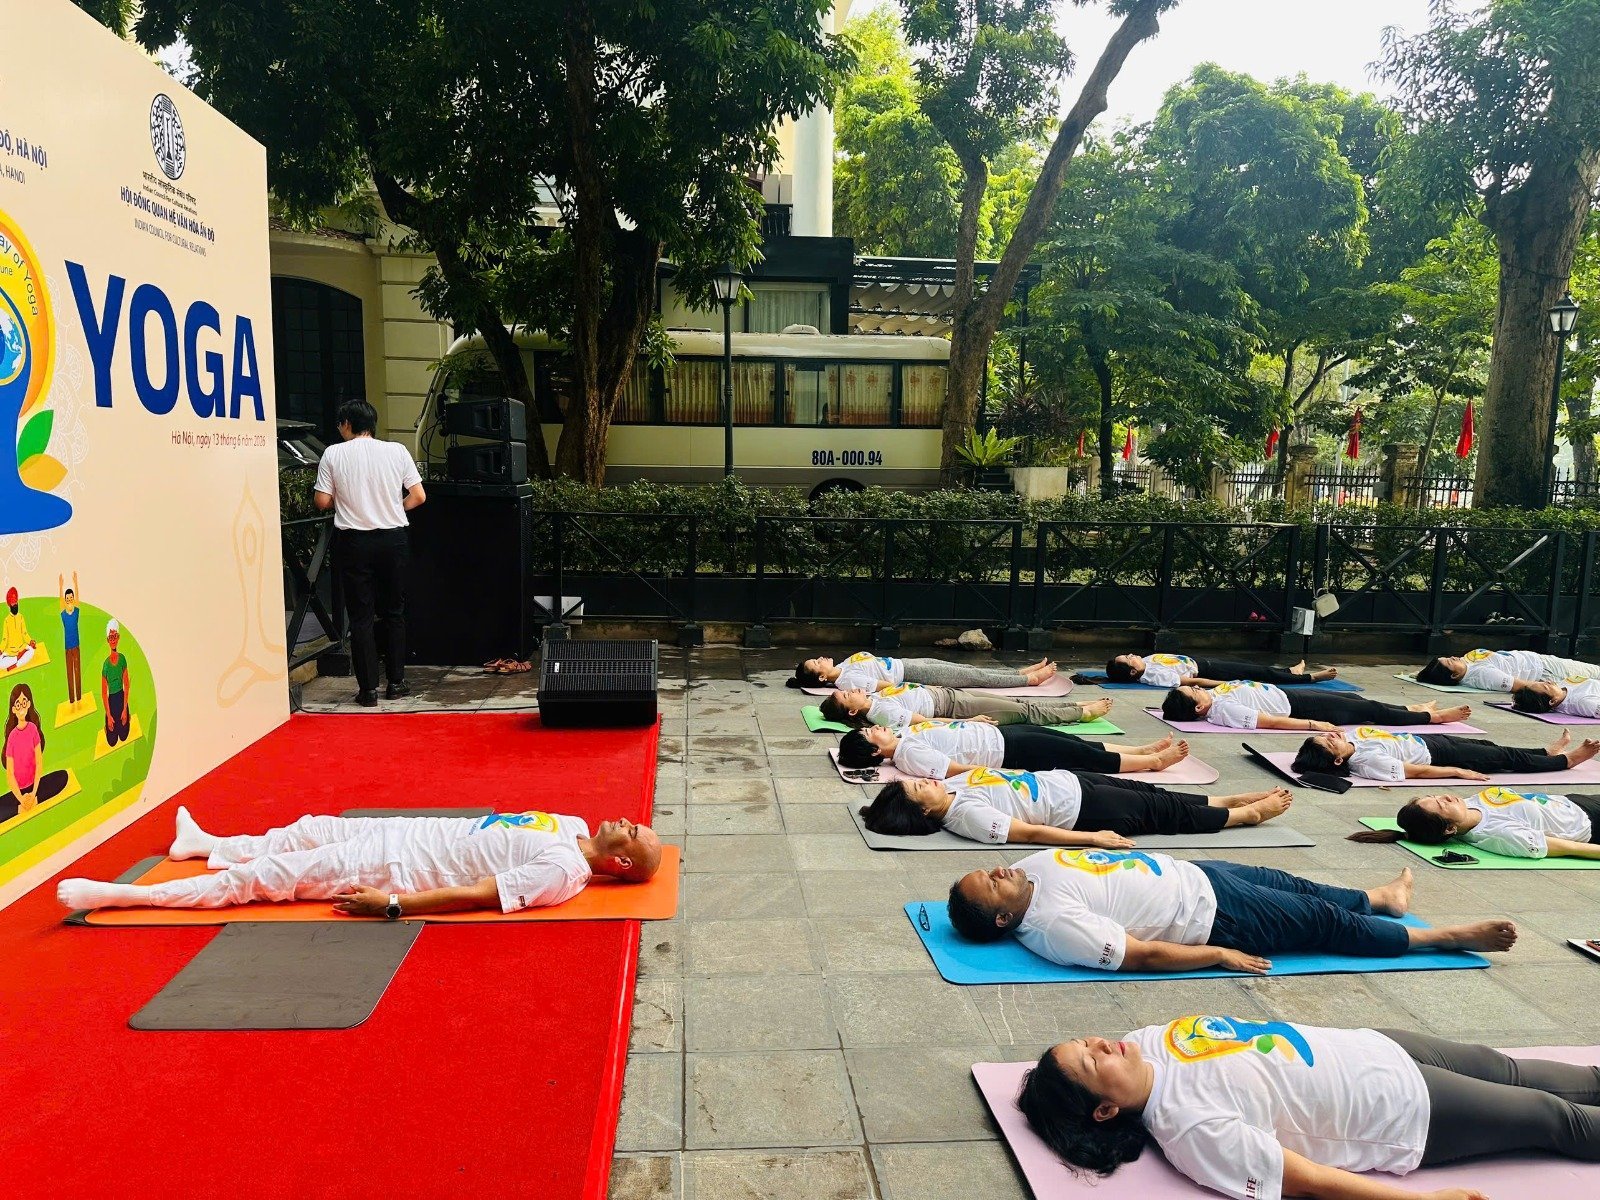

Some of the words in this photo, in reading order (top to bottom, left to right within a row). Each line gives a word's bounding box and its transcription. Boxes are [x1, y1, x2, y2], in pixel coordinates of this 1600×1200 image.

[16, 137, 30, 160] HÀ
[31, 145, 48, 171] NỘI
[6, 165, 26, 184] HANOI
[120, 185, 133, 207] HỘI
[151, 201, 168, 221] QUAN
[13, 251, 26, 269] of
[24, 269, 39, 316] Yoga
[64, 260, 266, 422] YOGA
[171, 431, 181, 445] Hà
[196, 432, 211, 449] ngày
[212, 433, 220, 446] 13
[220, 433, 236, 450] tháng
[242, 434, 253, 447] năm
[811, 450, 883, 466] 80A-000.94
[1246, 1176, 1257, 1199] LiFE
